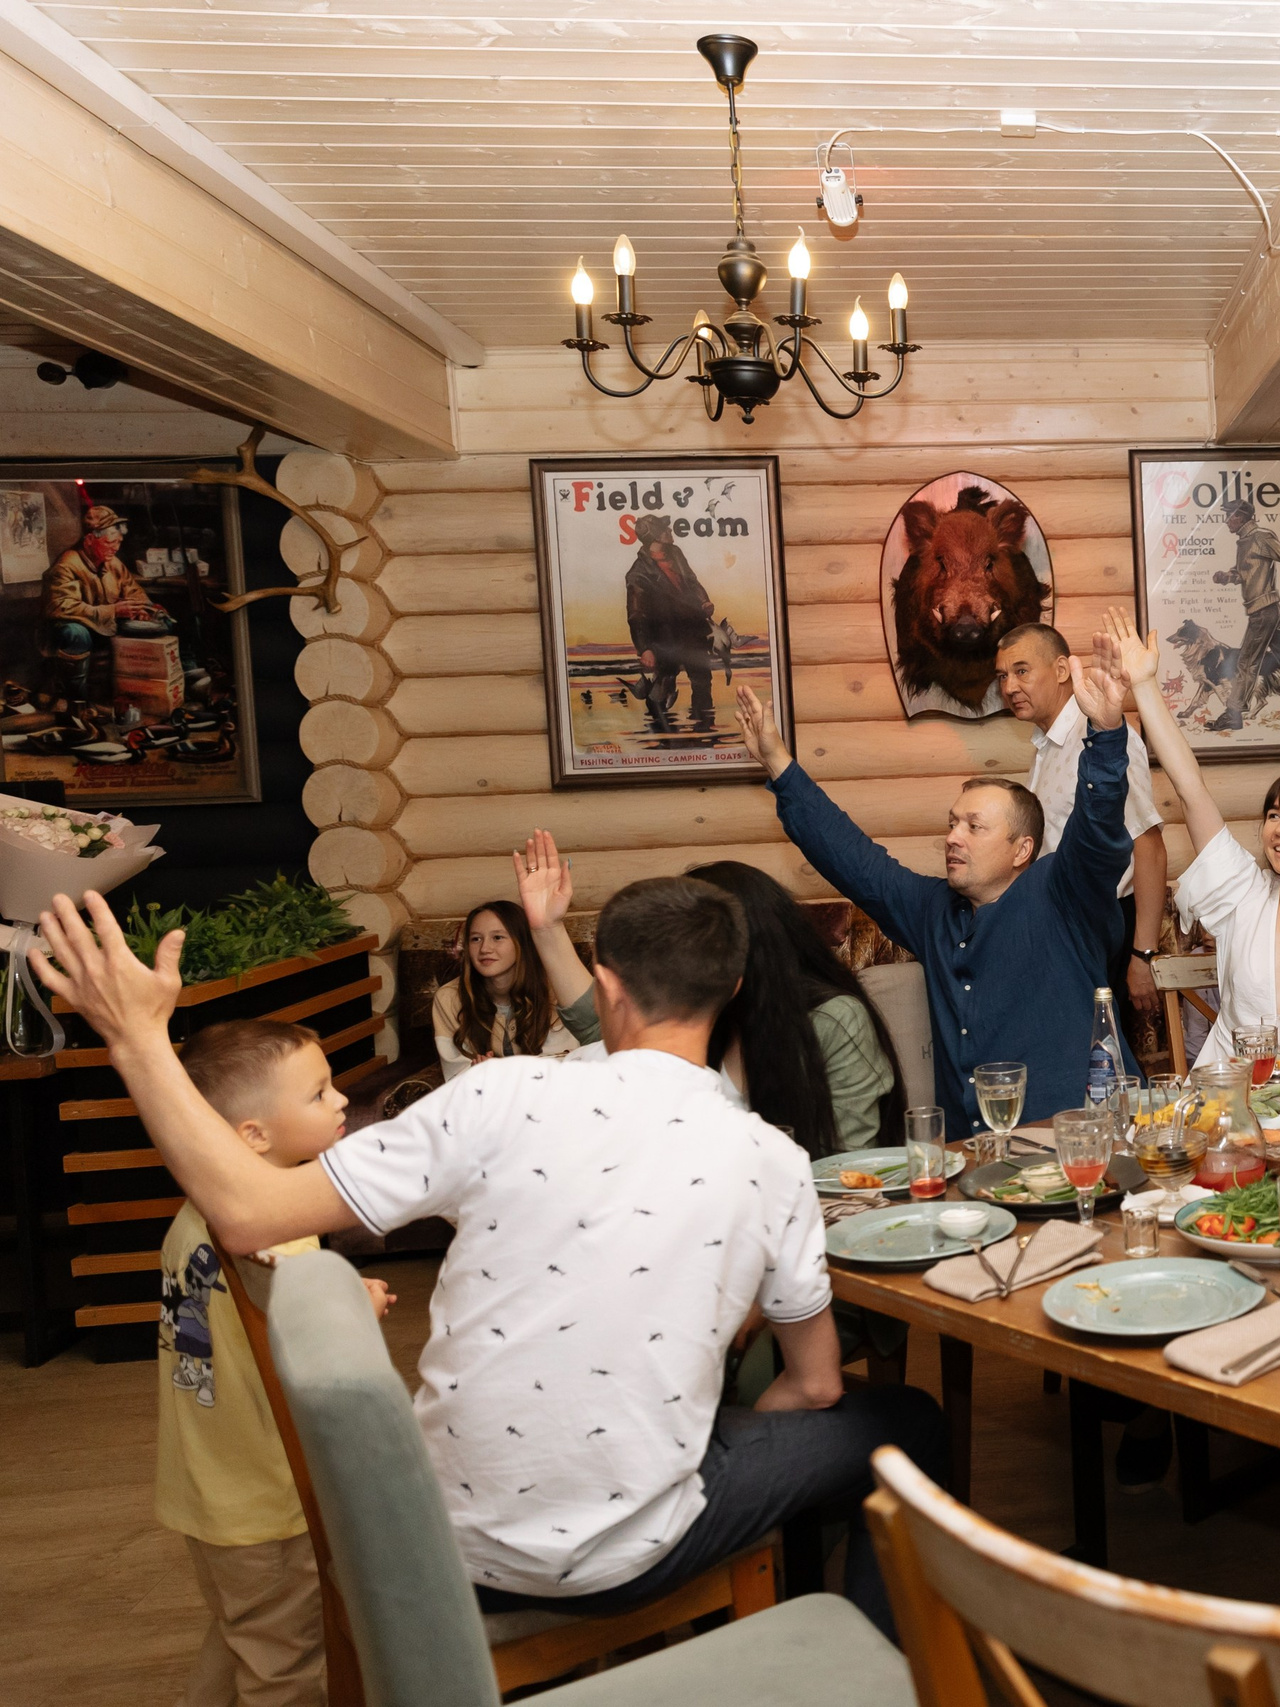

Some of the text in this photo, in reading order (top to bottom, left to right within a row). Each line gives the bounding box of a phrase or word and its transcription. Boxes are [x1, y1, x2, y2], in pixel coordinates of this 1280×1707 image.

[571, 481, 694, 512] Field &
[1163, 514, 1187, 524] THE
[1196, 513, 1260, 523] NATIL
[618, 514, 750, 545] Seam
[1180, 597, 1199, 605] Fight
[1217, 596, 1238, 604] Water
[580, 758, 614, 767] FISHING
[621, 756, 660, 765] HUNTING
[667, 754, 708, 763] CAMPING
[715, 752, 742, 761] BOATS
